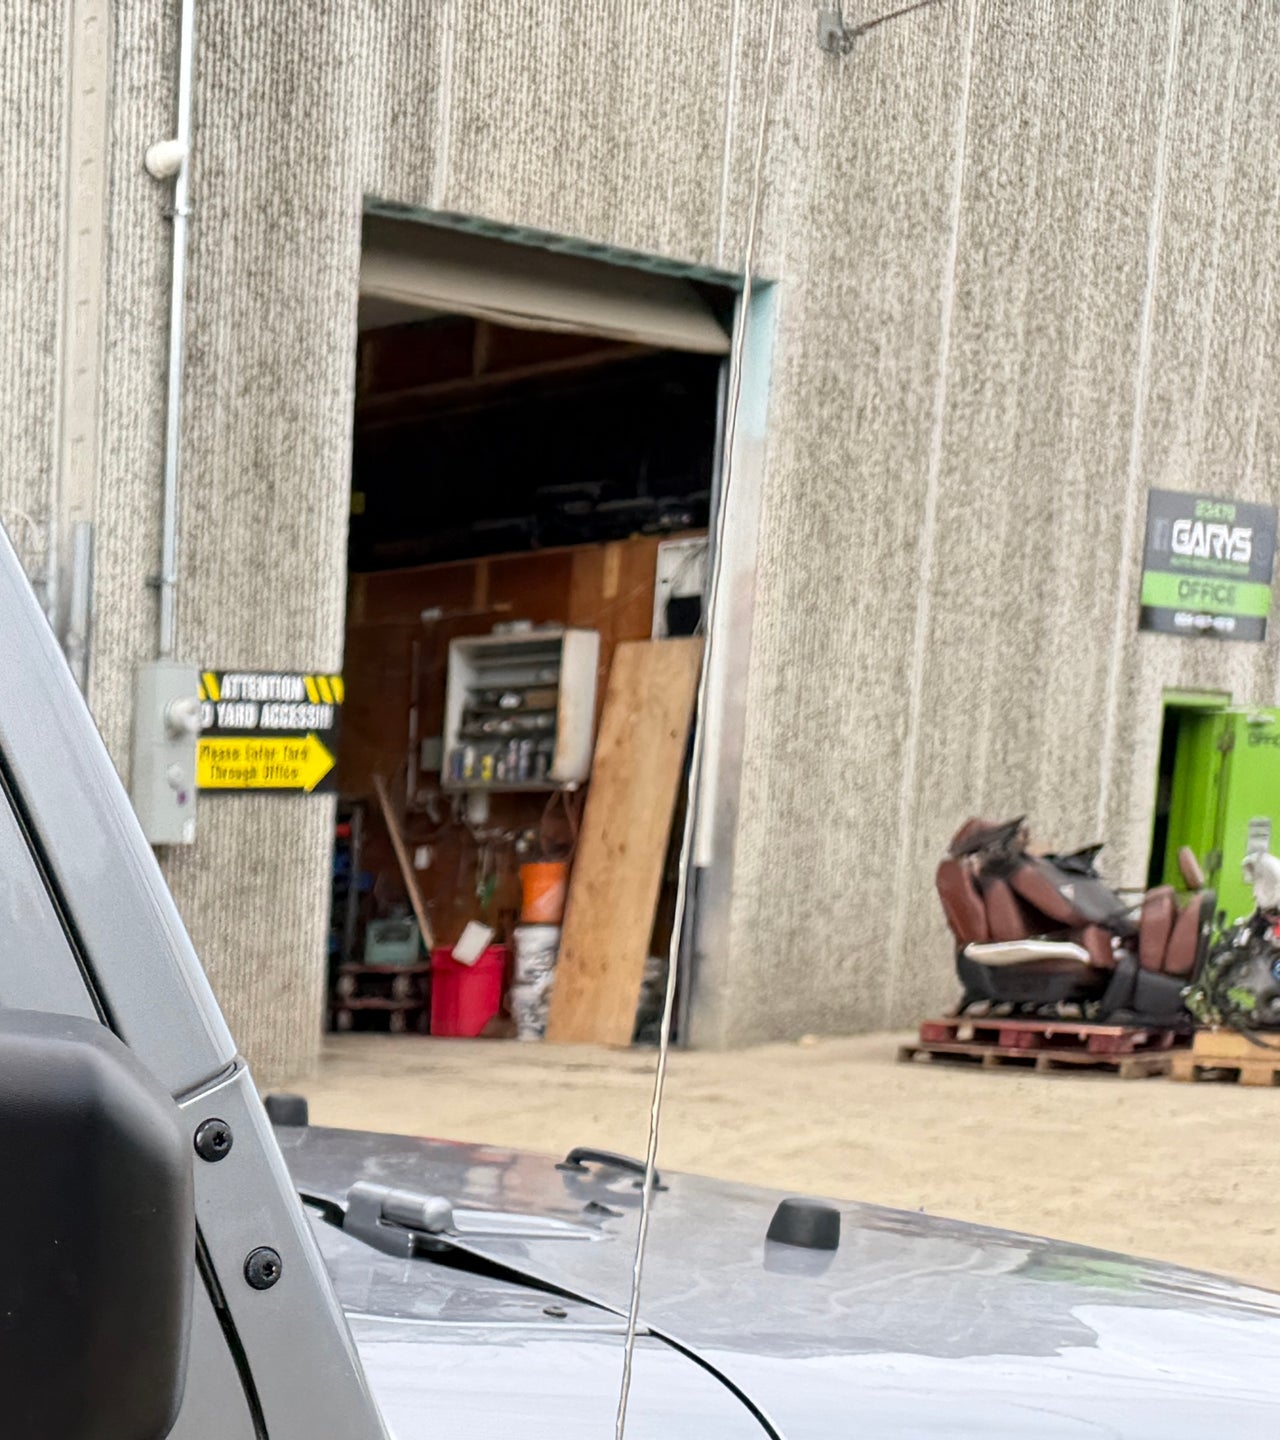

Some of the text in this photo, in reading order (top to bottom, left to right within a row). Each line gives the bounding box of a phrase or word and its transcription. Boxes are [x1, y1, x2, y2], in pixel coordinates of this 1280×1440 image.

[1171, 518, 1253, 563] GARYS
[1178, 579, 1236, 606] OFFICE
[221, 674, 305, 701] ATTENTION
[217, 702, 259, 729] YARD
